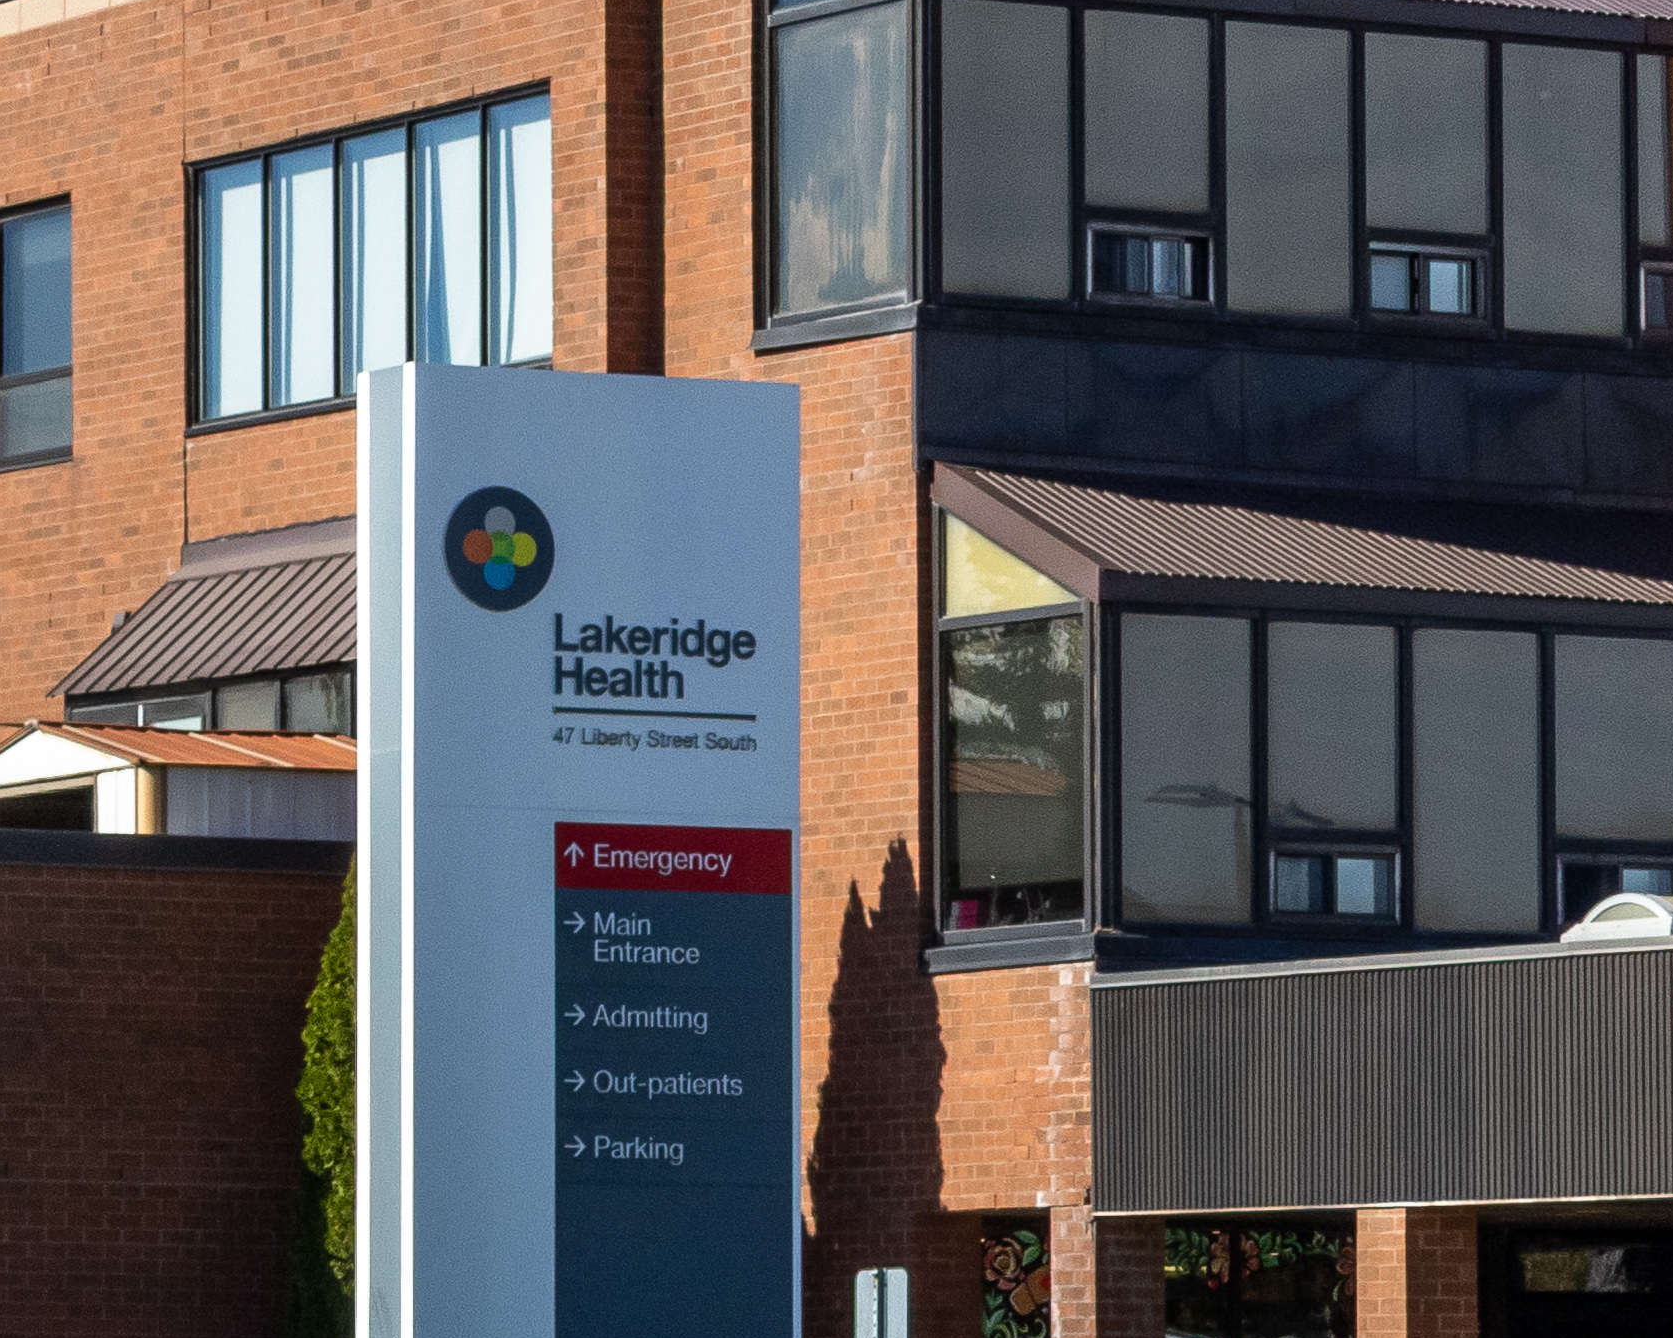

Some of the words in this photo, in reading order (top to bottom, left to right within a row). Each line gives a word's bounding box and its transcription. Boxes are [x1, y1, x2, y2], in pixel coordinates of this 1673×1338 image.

[554, 612, 757, 668] Lakeridge
[553, 655, 684, 700] Health
[552, 727, 575, 745] 47
[580, 728, 642, 752] Liberty
[646, 729, 700, 750] Street
[705, 732, 758, 752] South
[593, 843, 733, 878] Emergency
[593, 912, 652, 937] Main
[593, 939, 701, 964] Entrance
[592, 1004, 709, 1036] Admitting
[593, 1069, 744, 1100] Out-patients
[593, 1135, 685, 1166] Parking
